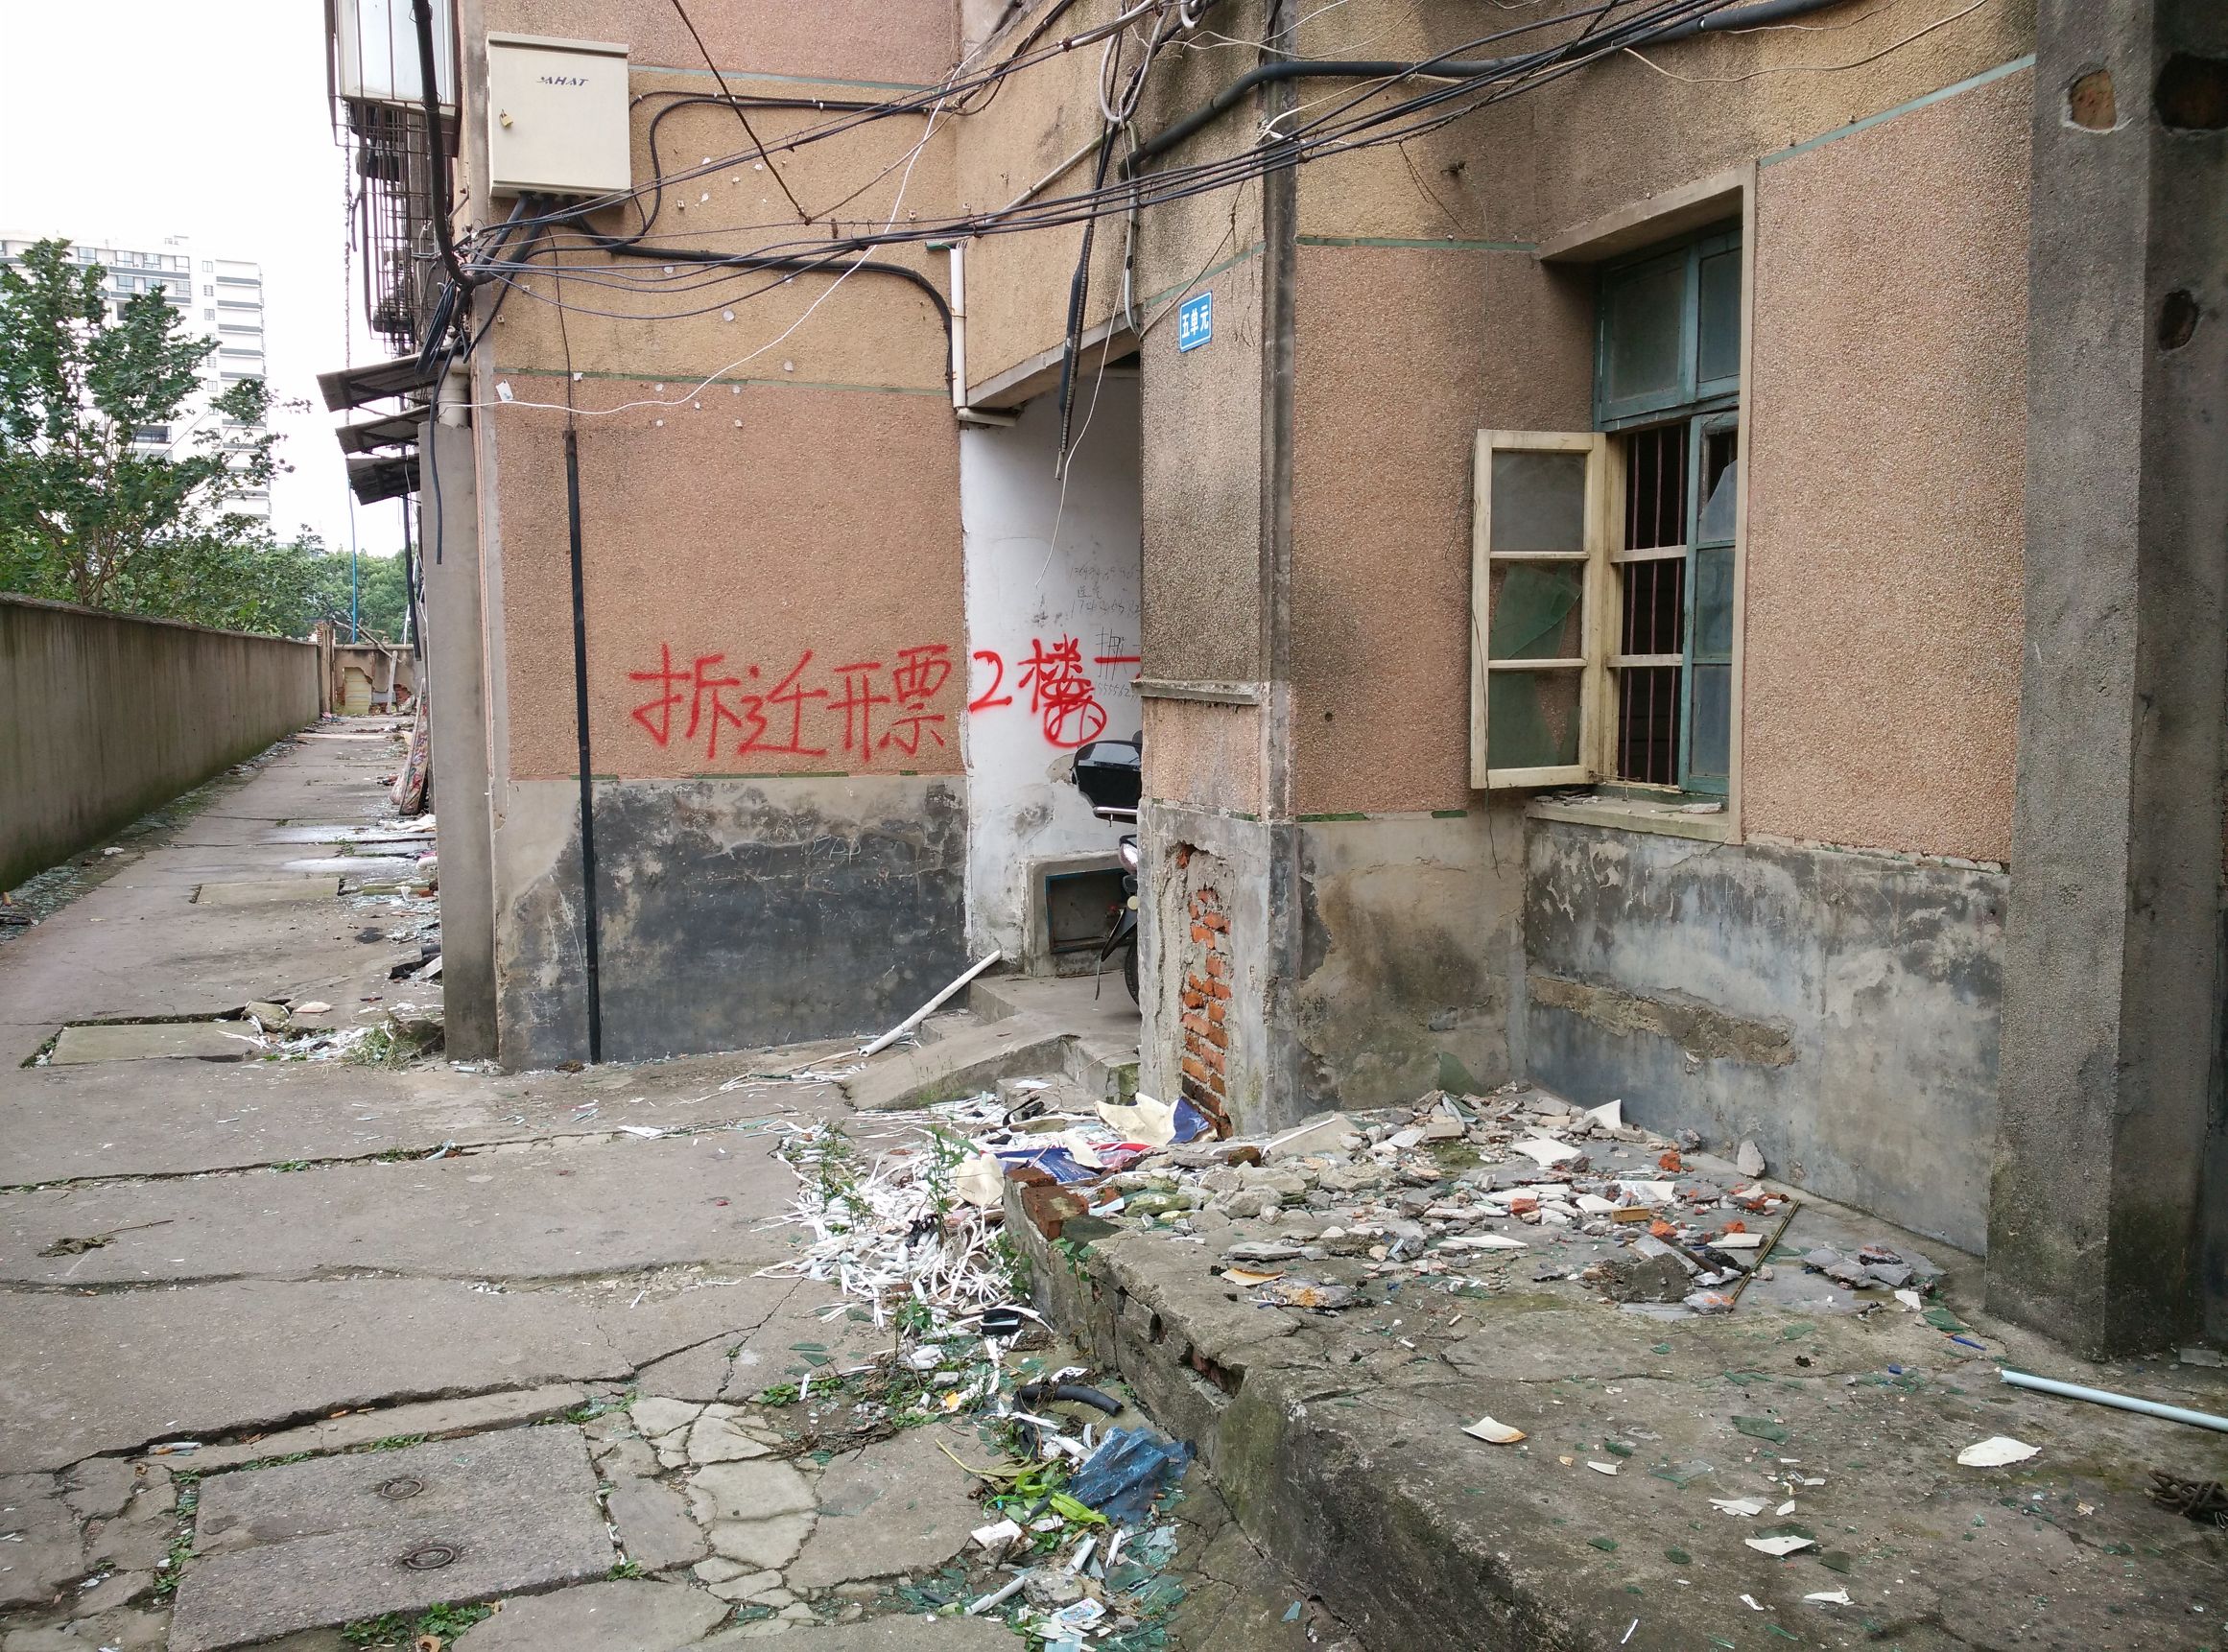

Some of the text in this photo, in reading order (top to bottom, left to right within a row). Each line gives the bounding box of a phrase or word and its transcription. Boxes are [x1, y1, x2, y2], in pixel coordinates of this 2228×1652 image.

[1182, 304, 1209, 339] 五单元
[628, 644, 952, 763] 拆迁开票
